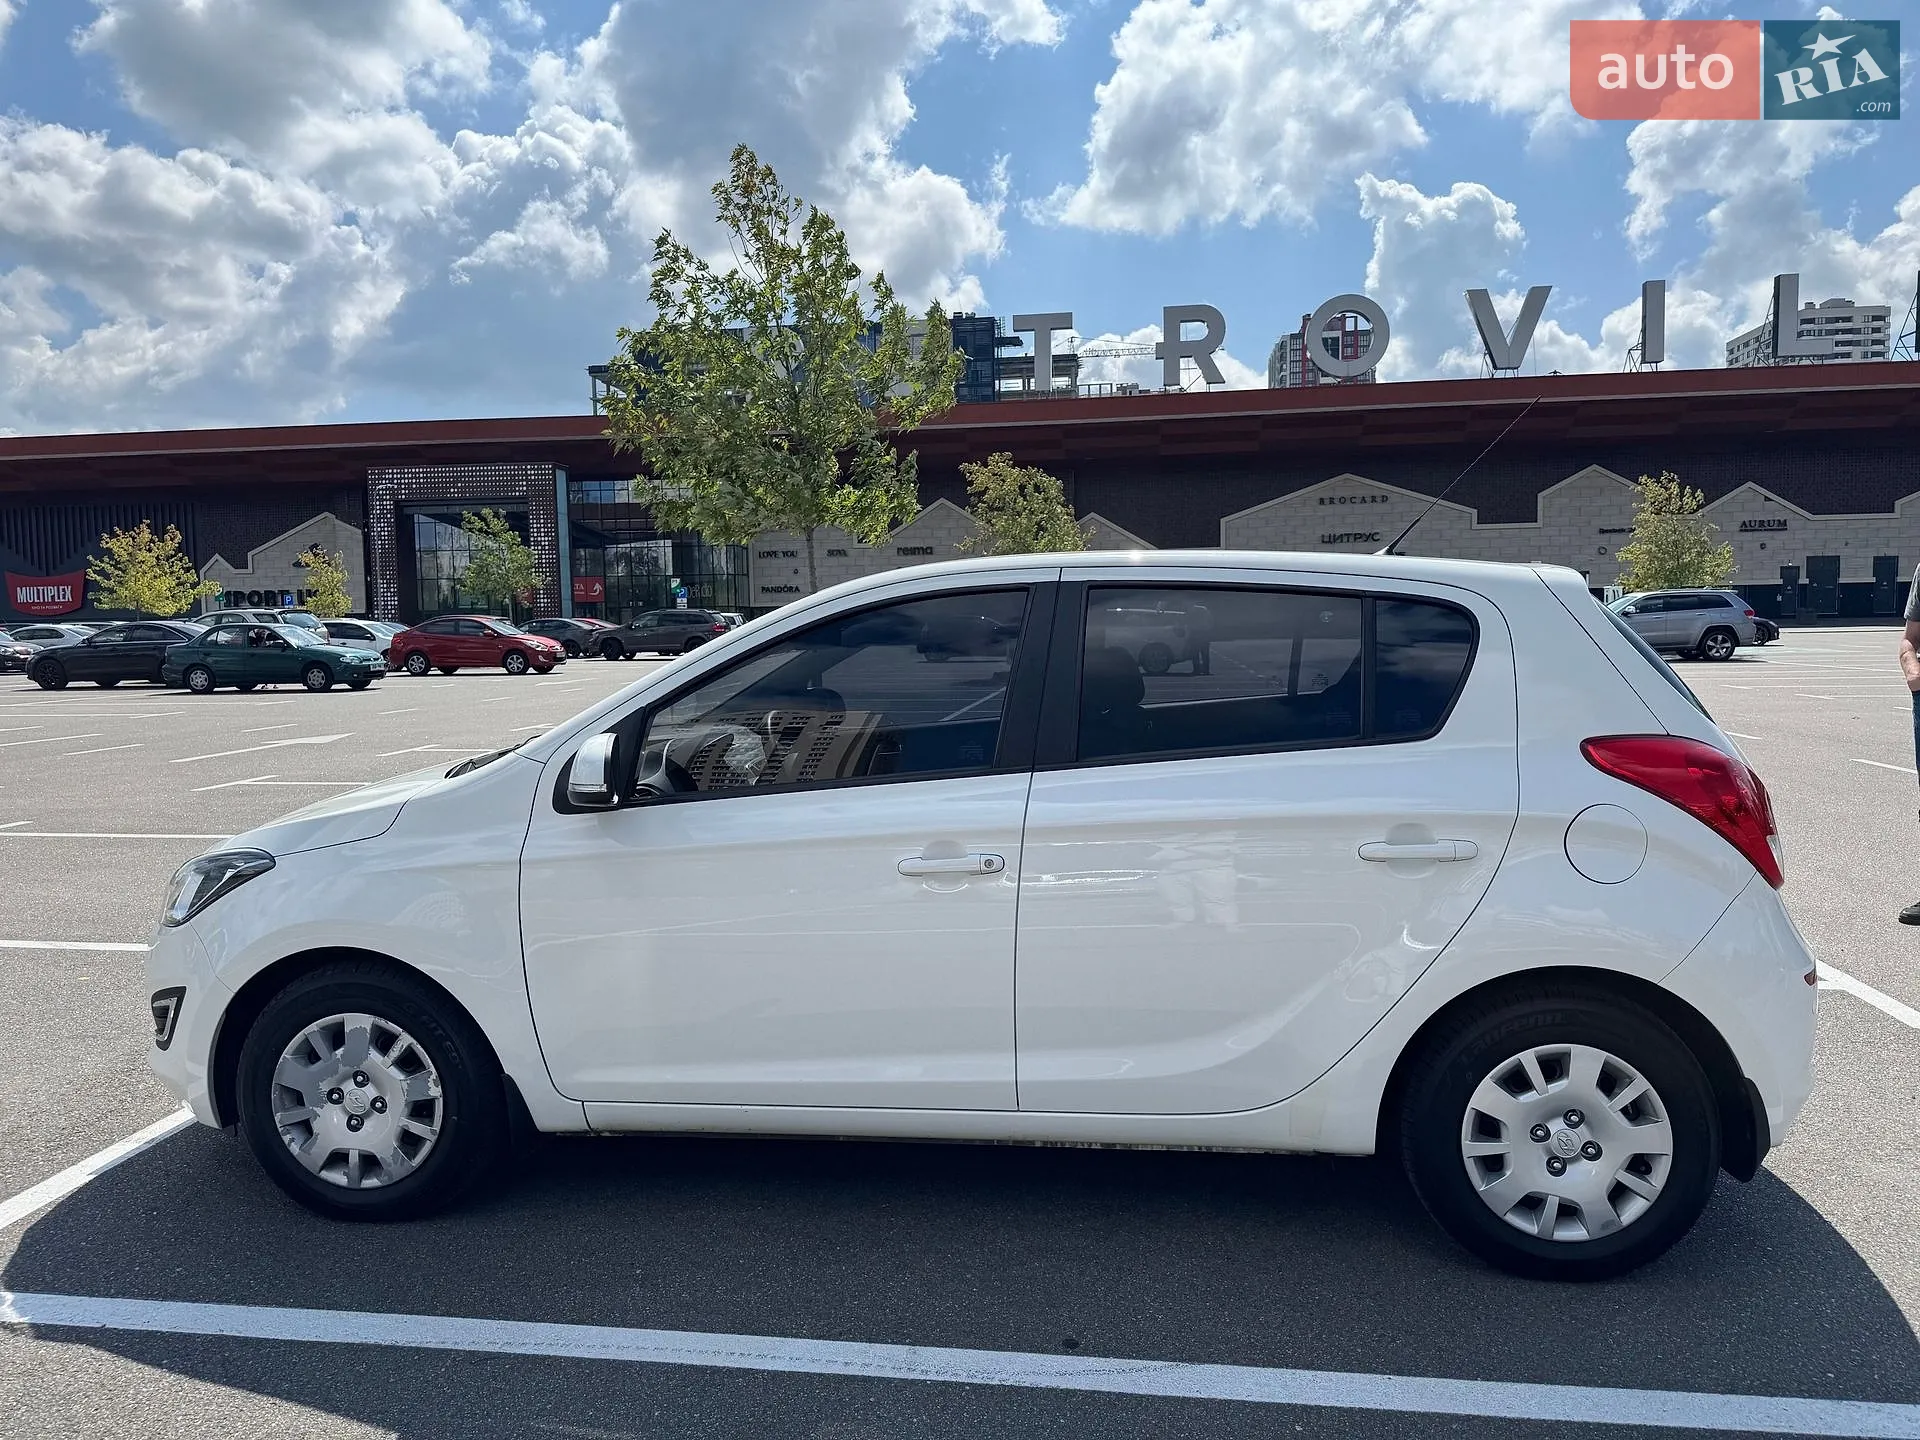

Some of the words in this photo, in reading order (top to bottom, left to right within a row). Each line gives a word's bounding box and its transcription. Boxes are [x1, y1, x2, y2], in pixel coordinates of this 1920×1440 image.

[1319, 495, 1389, 505] BROCARD
[1739, 519, 1788, 528] AURUM
[1321, 532, 1380, 544] ЦИТРУС
[758, 550, 779, 559] LOVE
[782, 550, 798, 558] YOU
[897, 546, 933, 556] reima
[16, 586, 72, 603] MULTIPLEX
[223, 589, 290, 607] SPORT
